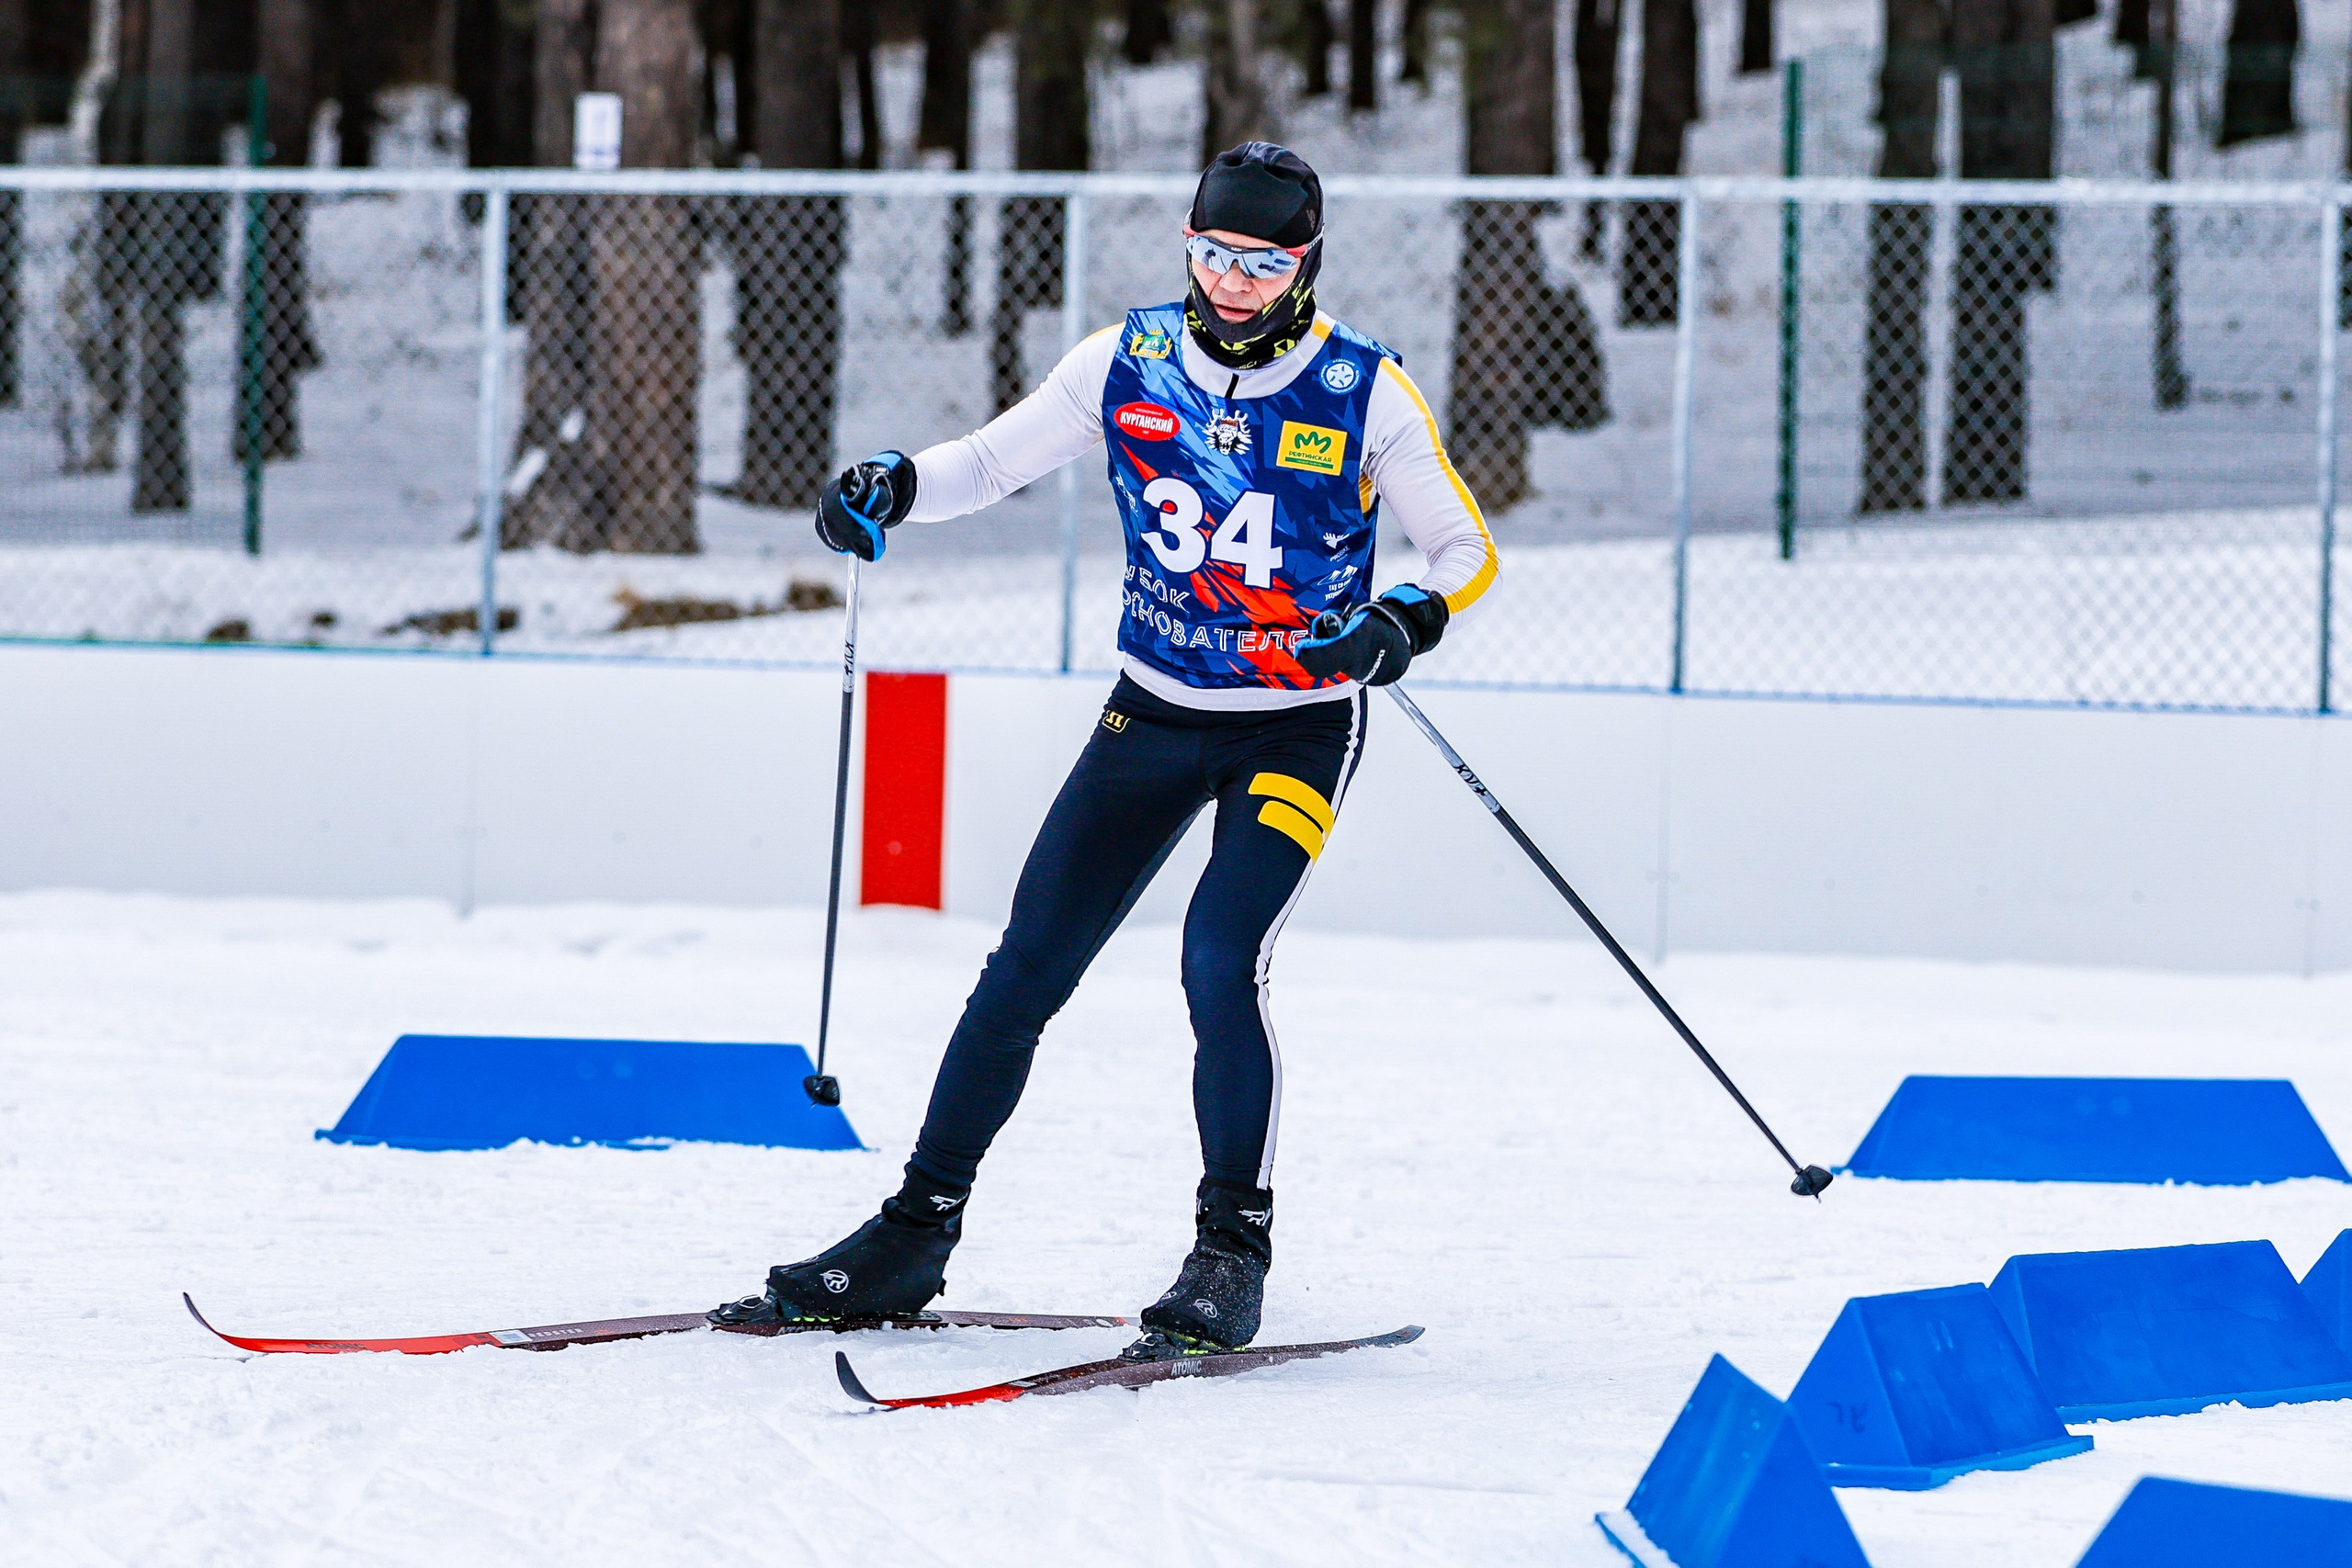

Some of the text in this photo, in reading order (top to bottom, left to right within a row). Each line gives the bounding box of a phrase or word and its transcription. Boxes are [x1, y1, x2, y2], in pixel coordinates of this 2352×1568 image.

[1120, 411, 1174, 434] КУРГАНСКИЙ
[1288, 450, 1332, 463] РЕФТИНСКАЯ
[1140, 477, 1283, 589] 34
[1170, 1359, 1203, 1376] ATOMIC
